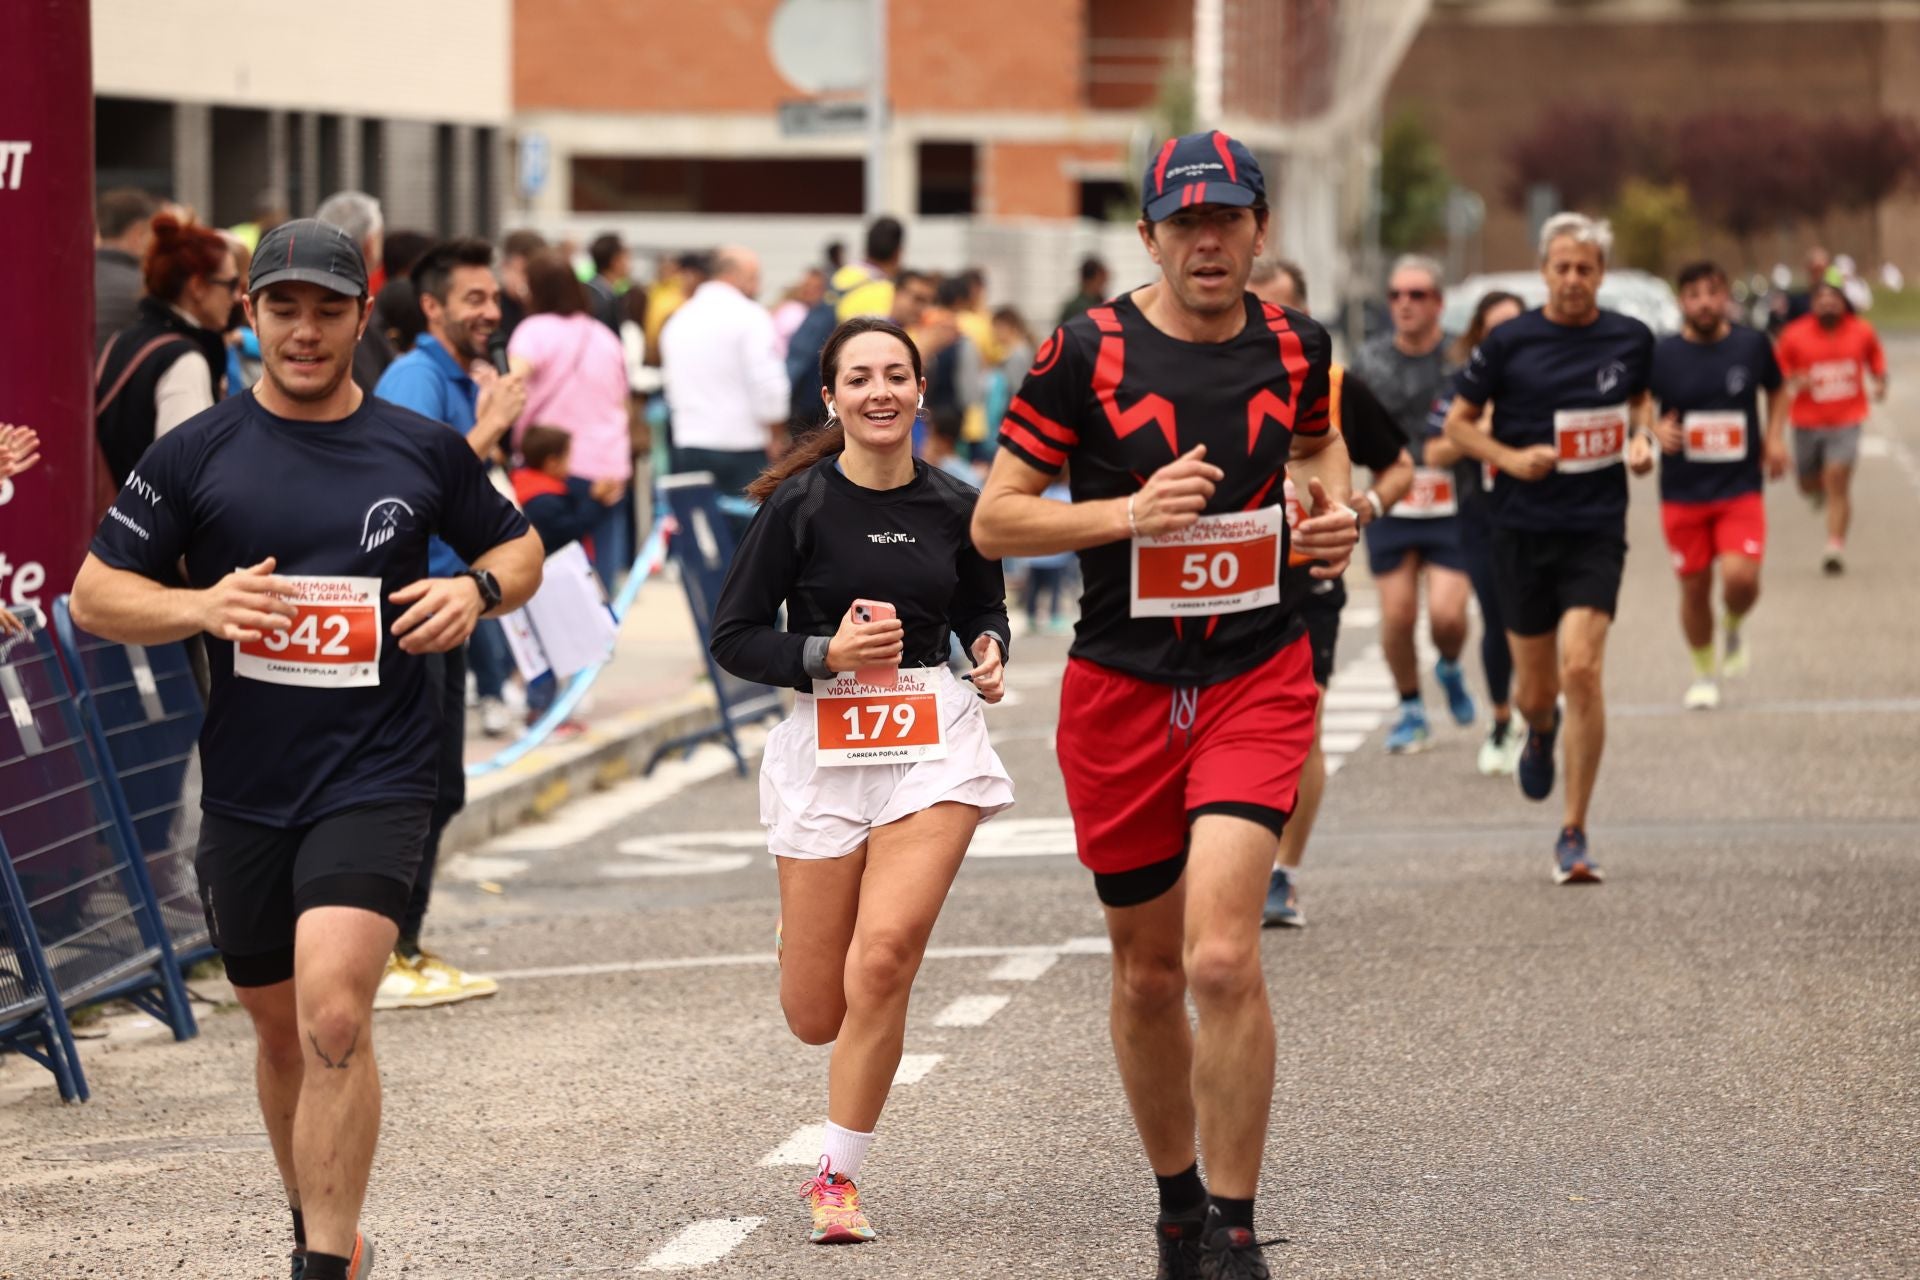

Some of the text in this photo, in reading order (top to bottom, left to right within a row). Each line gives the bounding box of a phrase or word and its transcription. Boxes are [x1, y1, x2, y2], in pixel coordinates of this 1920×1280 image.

[1194, 519, 1256, 533] MEMORIAL
[1180, 551, 1239, 591] 50
[1170, 598, 1242, 609] CARRERA POPULAR
[267, 663, 338, 676] CARRERA POPULAR
[842, 703, 916, 741] 179
[847, 751, 878, 759] CARRERA
